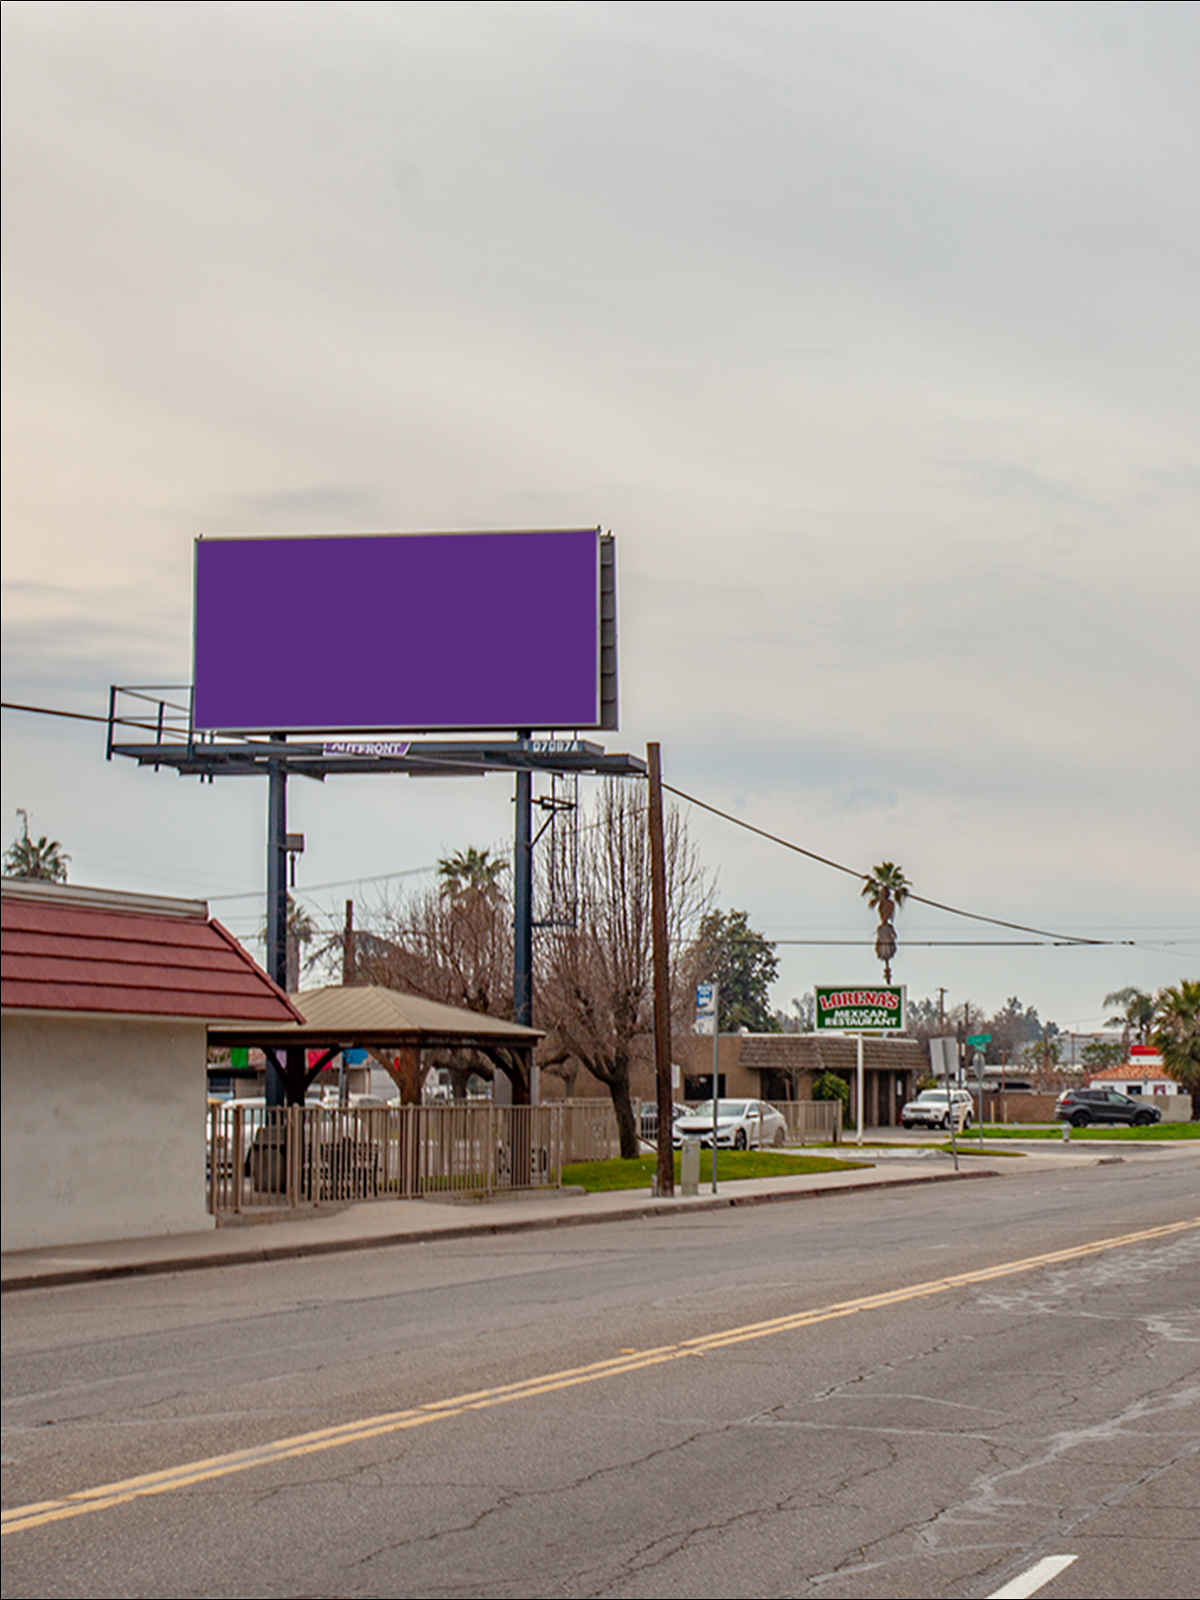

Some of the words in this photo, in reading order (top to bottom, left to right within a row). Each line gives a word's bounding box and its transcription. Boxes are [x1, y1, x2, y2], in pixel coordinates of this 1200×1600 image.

[819, 989, 900, 1011] LORENA'S
[833, 1009, 888, 1018] MEXICAN
[824, 1016, 898, 1026] RESTAURANT
